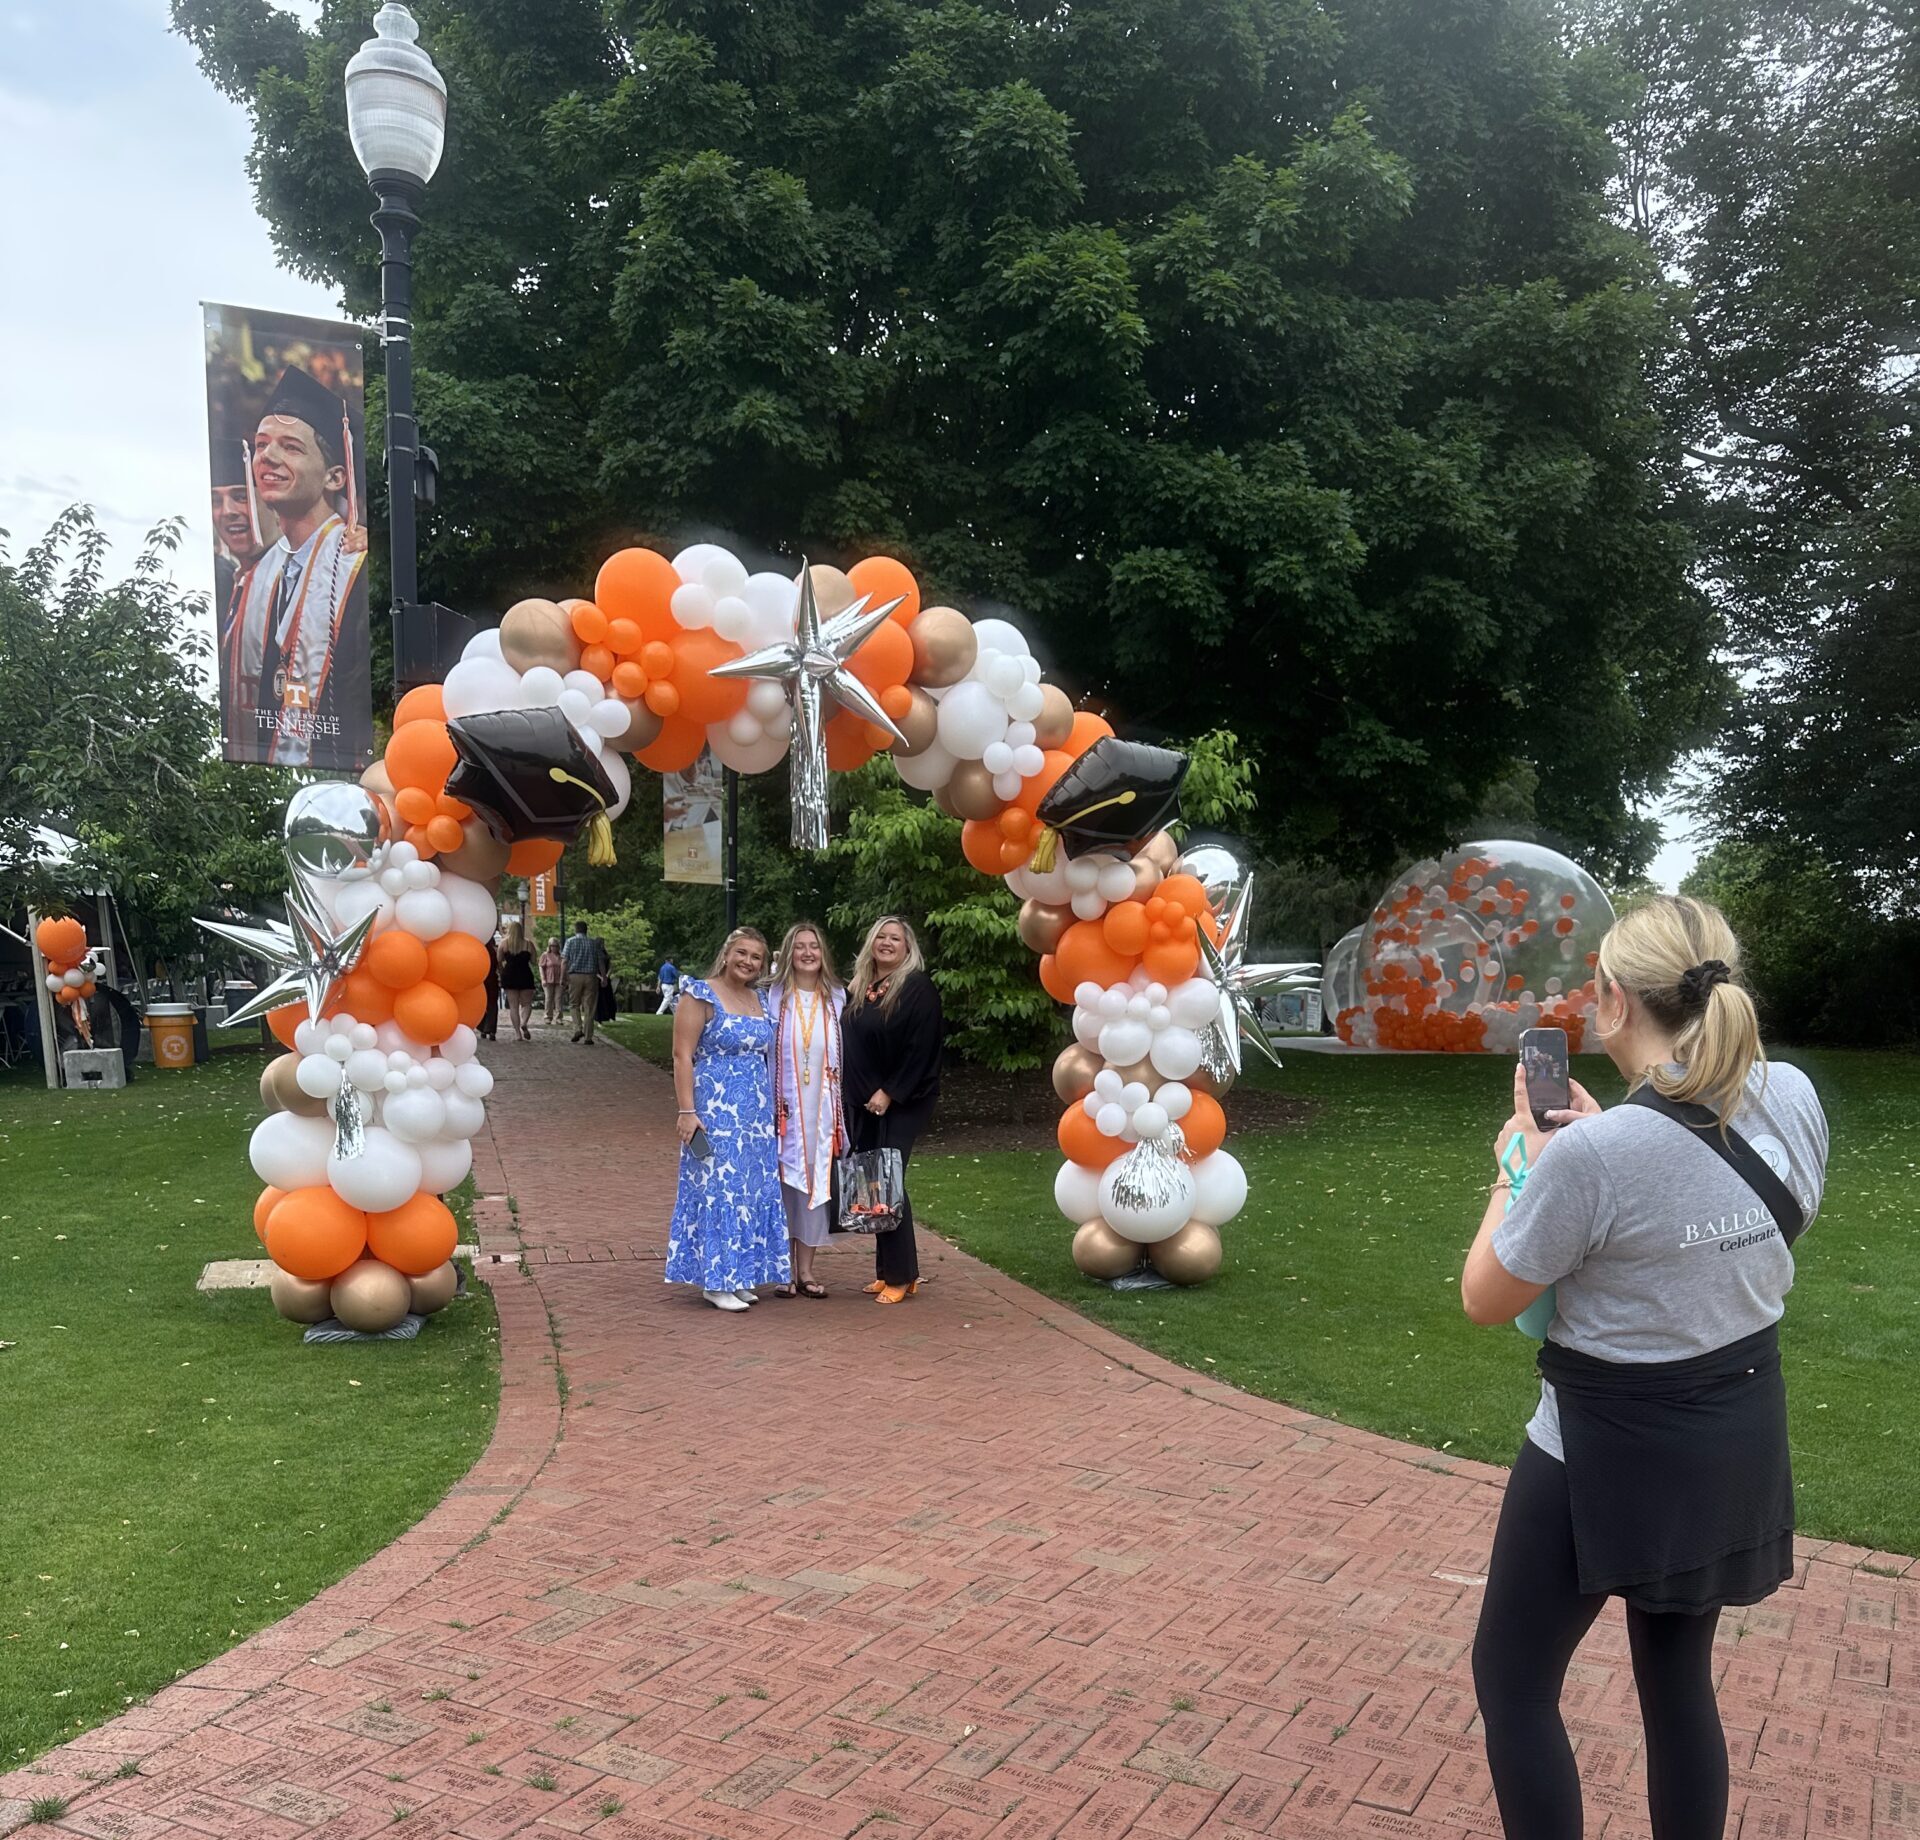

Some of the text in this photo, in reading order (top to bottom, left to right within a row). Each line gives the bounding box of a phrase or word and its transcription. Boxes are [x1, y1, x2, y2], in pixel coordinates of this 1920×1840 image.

[286, 684, 306, 704] T
[255, 708, 272, 716] THE
[276, 711, 327, 721] UNIVERSITY
[255, 715, 341, 735] TENNESSEE
[277, 731, 322, 740] KNOXVILLE
[1720, 1227, 1776, 1252] Celebrate
[826, 1721, 865, 1735] BRANDON
[1297, 1744, 1334, 1756] DONNA
[432, 1765, 497, 1789] CHRISTOPHER
[998, 1766, 1089, 1795] KELLY ELIZABETH
[1119, 1772, 1162, 1787] SEATON
[342, 1779, 423, 1806] CAMILLE PEDIGO
[932, 1784, 991, 1804] FERNANDEZ
[479, 1803, 521, 1824] STACEY
[497, 1803, 538, 1824] ABBOTT
[786, 1806, 826, 1822] CURTIS
[789, 1799, 822, 1812] TEENA
[853, 1793, 920, 1816] MARTINDALE
[1454, 1806, 1486, 1818] JOHN
[391, 1814, 434, 1836] DONALD
[1093, 1805, 1131, 1832] LAFFERTY
[1369, 1813, 1422, 1829] JENNIFER
[1367, 1820, 1434, 1840] HENDRICKS
